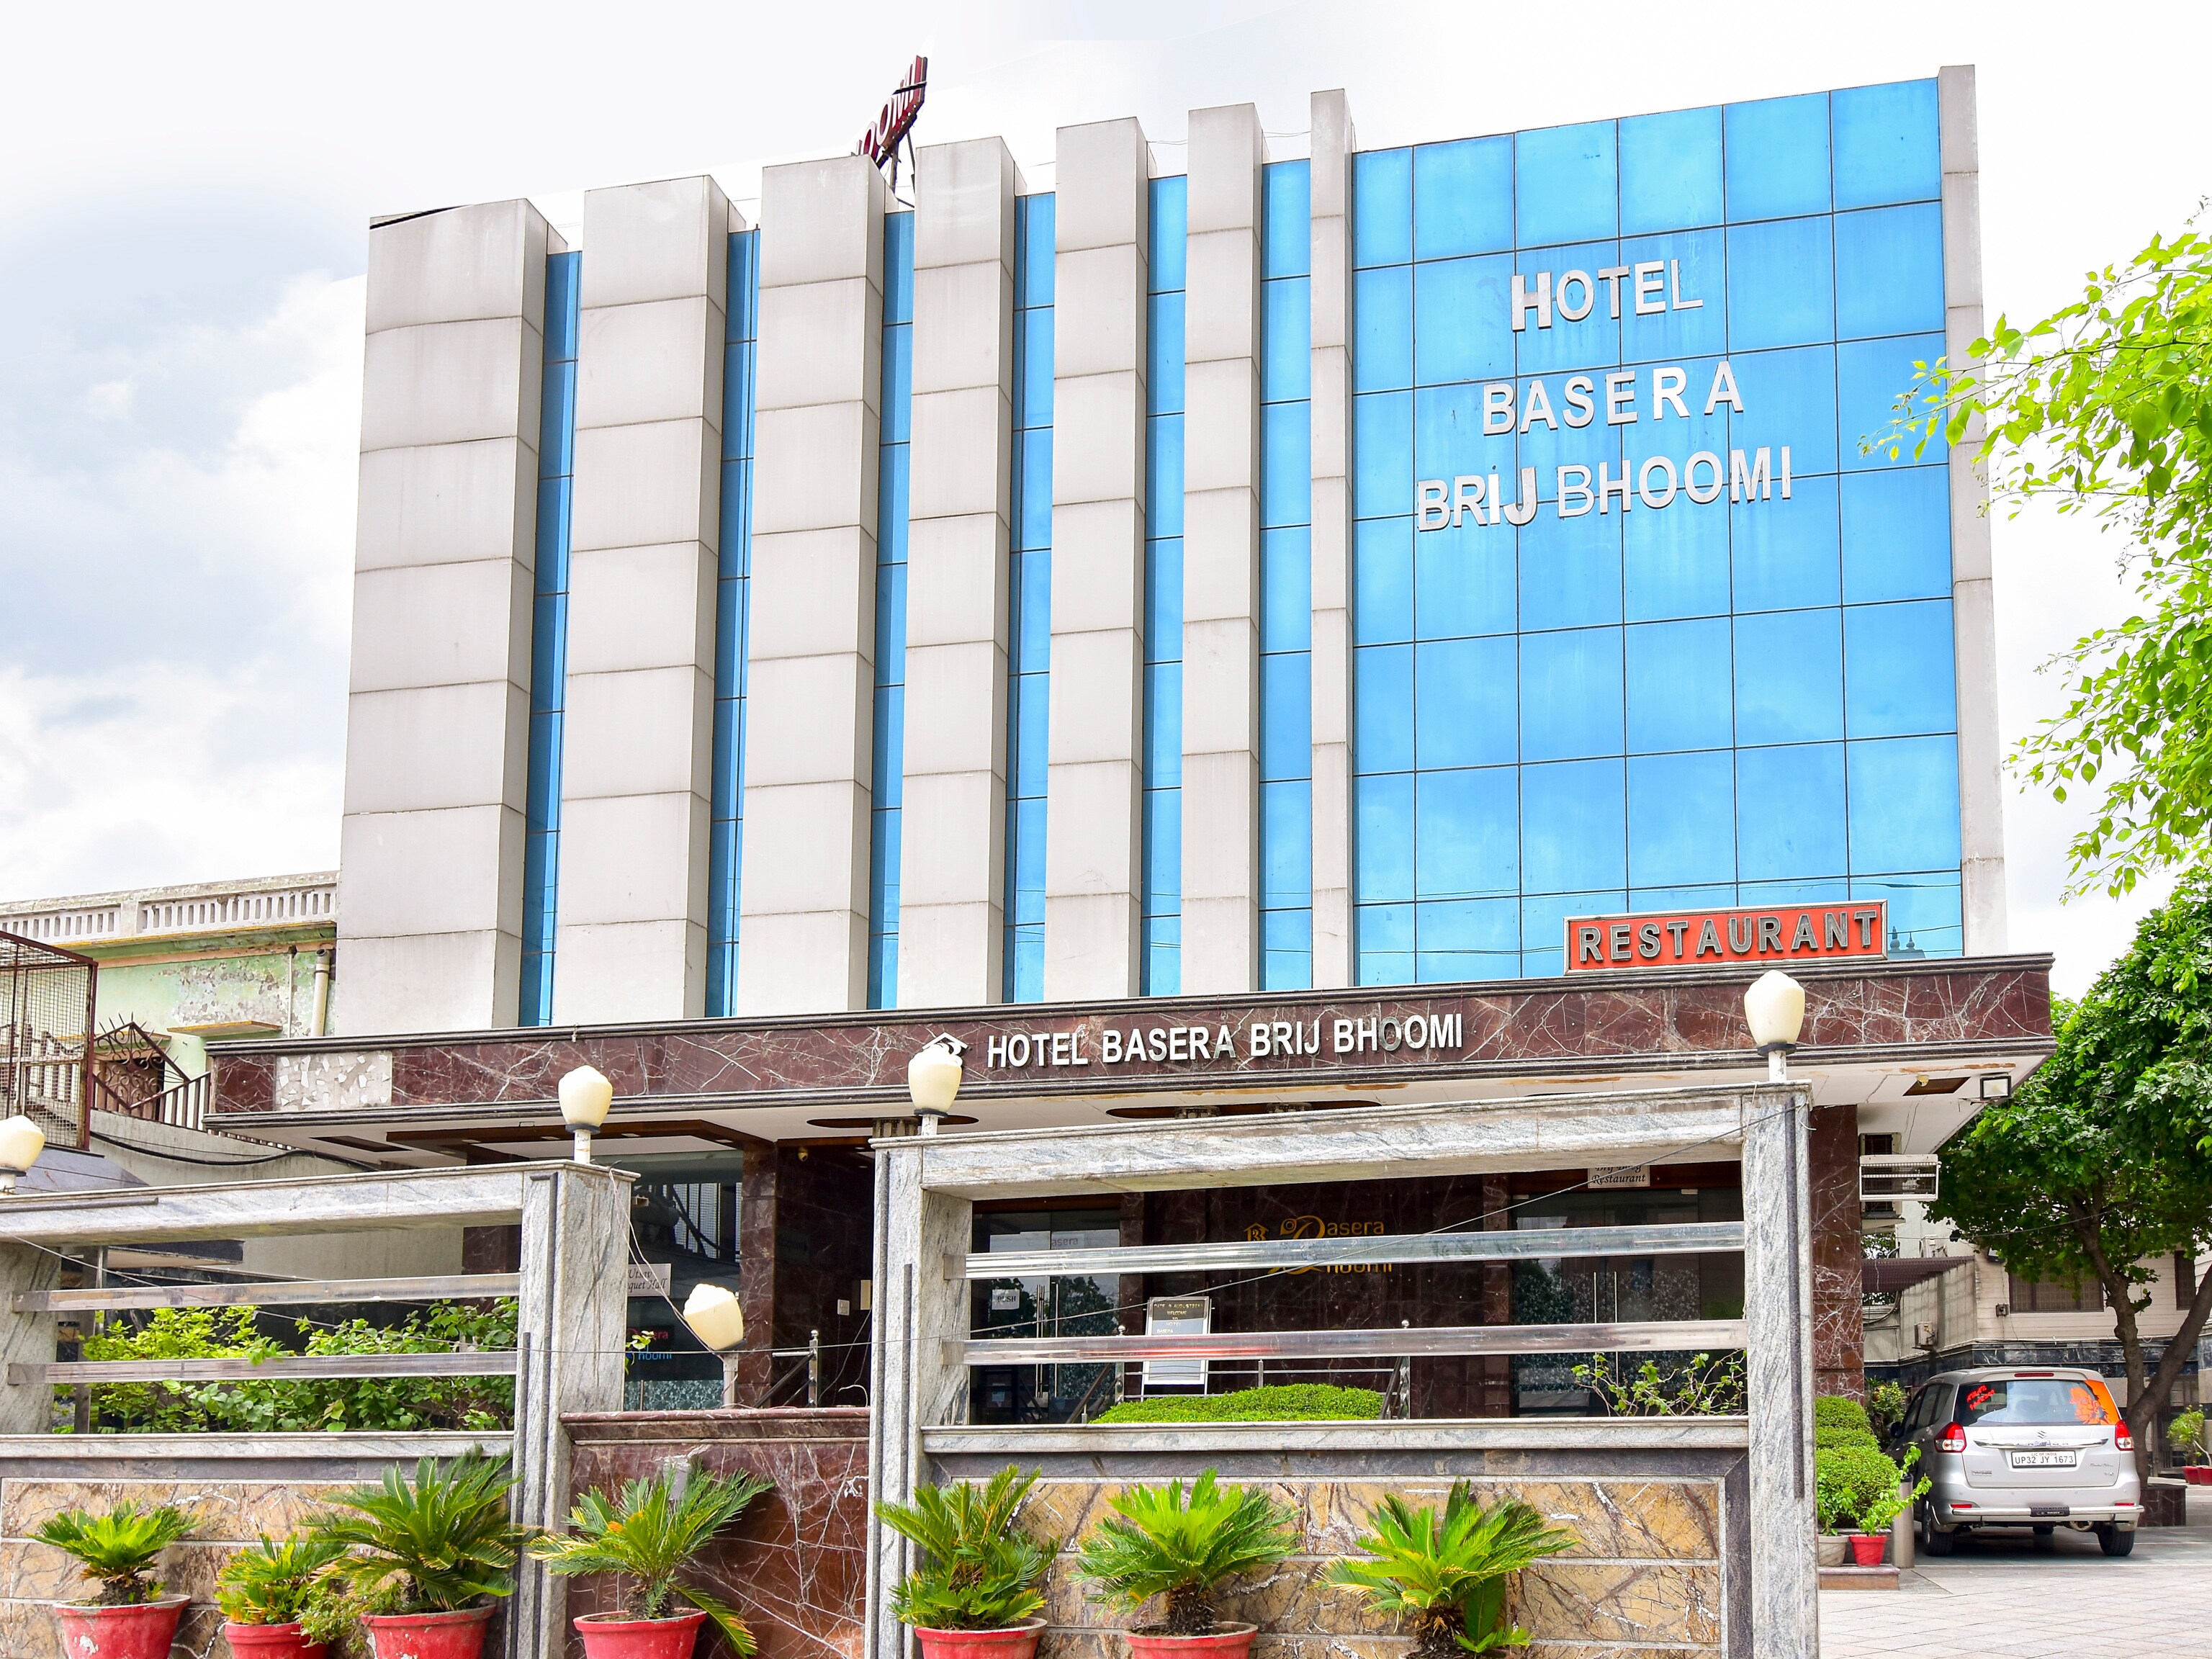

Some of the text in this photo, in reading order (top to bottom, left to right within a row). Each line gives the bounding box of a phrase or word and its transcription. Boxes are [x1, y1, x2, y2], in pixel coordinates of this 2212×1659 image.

[1511, 259, 1704, 331] HOTEL
[1483, 360, 1744, 436] BASERA
[1418, 446, 1792, 532] BRIJ BHOOMI
[1578, 909, 1876, 963] RESTAURANT
[987, 1013, 1462, 1069] HOTEL BASERA BRIJ BHOOMI
[1591, 1174, 1646, 1185] Restaurant
